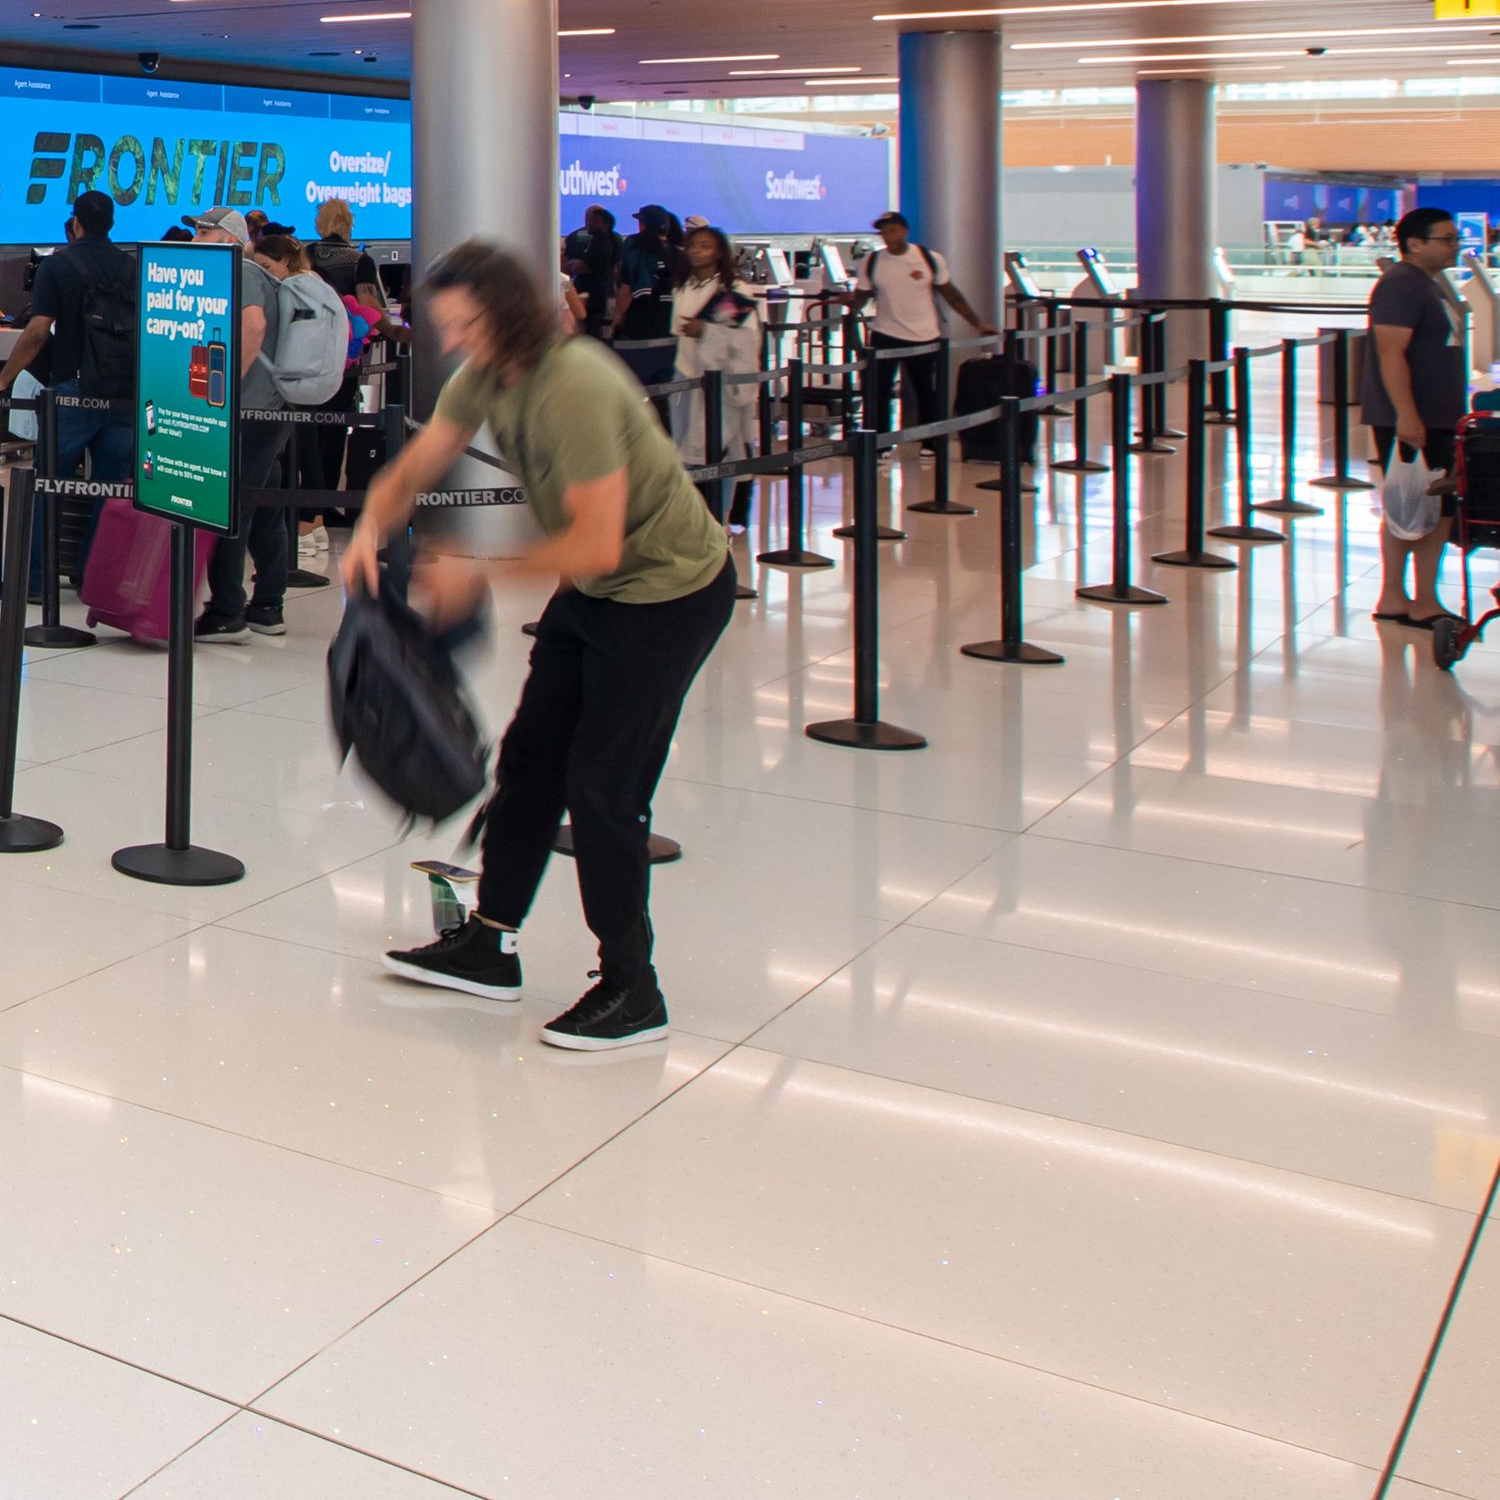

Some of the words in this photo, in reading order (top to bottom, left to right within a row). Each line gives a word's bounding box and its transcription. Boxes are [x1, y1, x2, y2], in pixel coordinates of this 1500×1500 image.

[14, 79, 28, 89] Agent
[28, 80, 52, 90] Assistance
[26, 131, 286, 207] FRONTIER
[329, 150, 391, 178] Oversize/
[560, 159, 620, 196] uthwest
[306, 180, 381, 208] Overweight
[766, 170, 822, 200] Southwest
[147, 262, 178, 284] Have
[180, 268, 204, 289] you
[146, 288, 174, 312] paid
[175, 290, 194, 312] for
[196, 296, 228, 318] your
[146, 318, 205, 341] carry-on?
[240, 408, 346, 424] YFRONTIER.COM
[415, 488, 527, 506] RONTIER.CO
